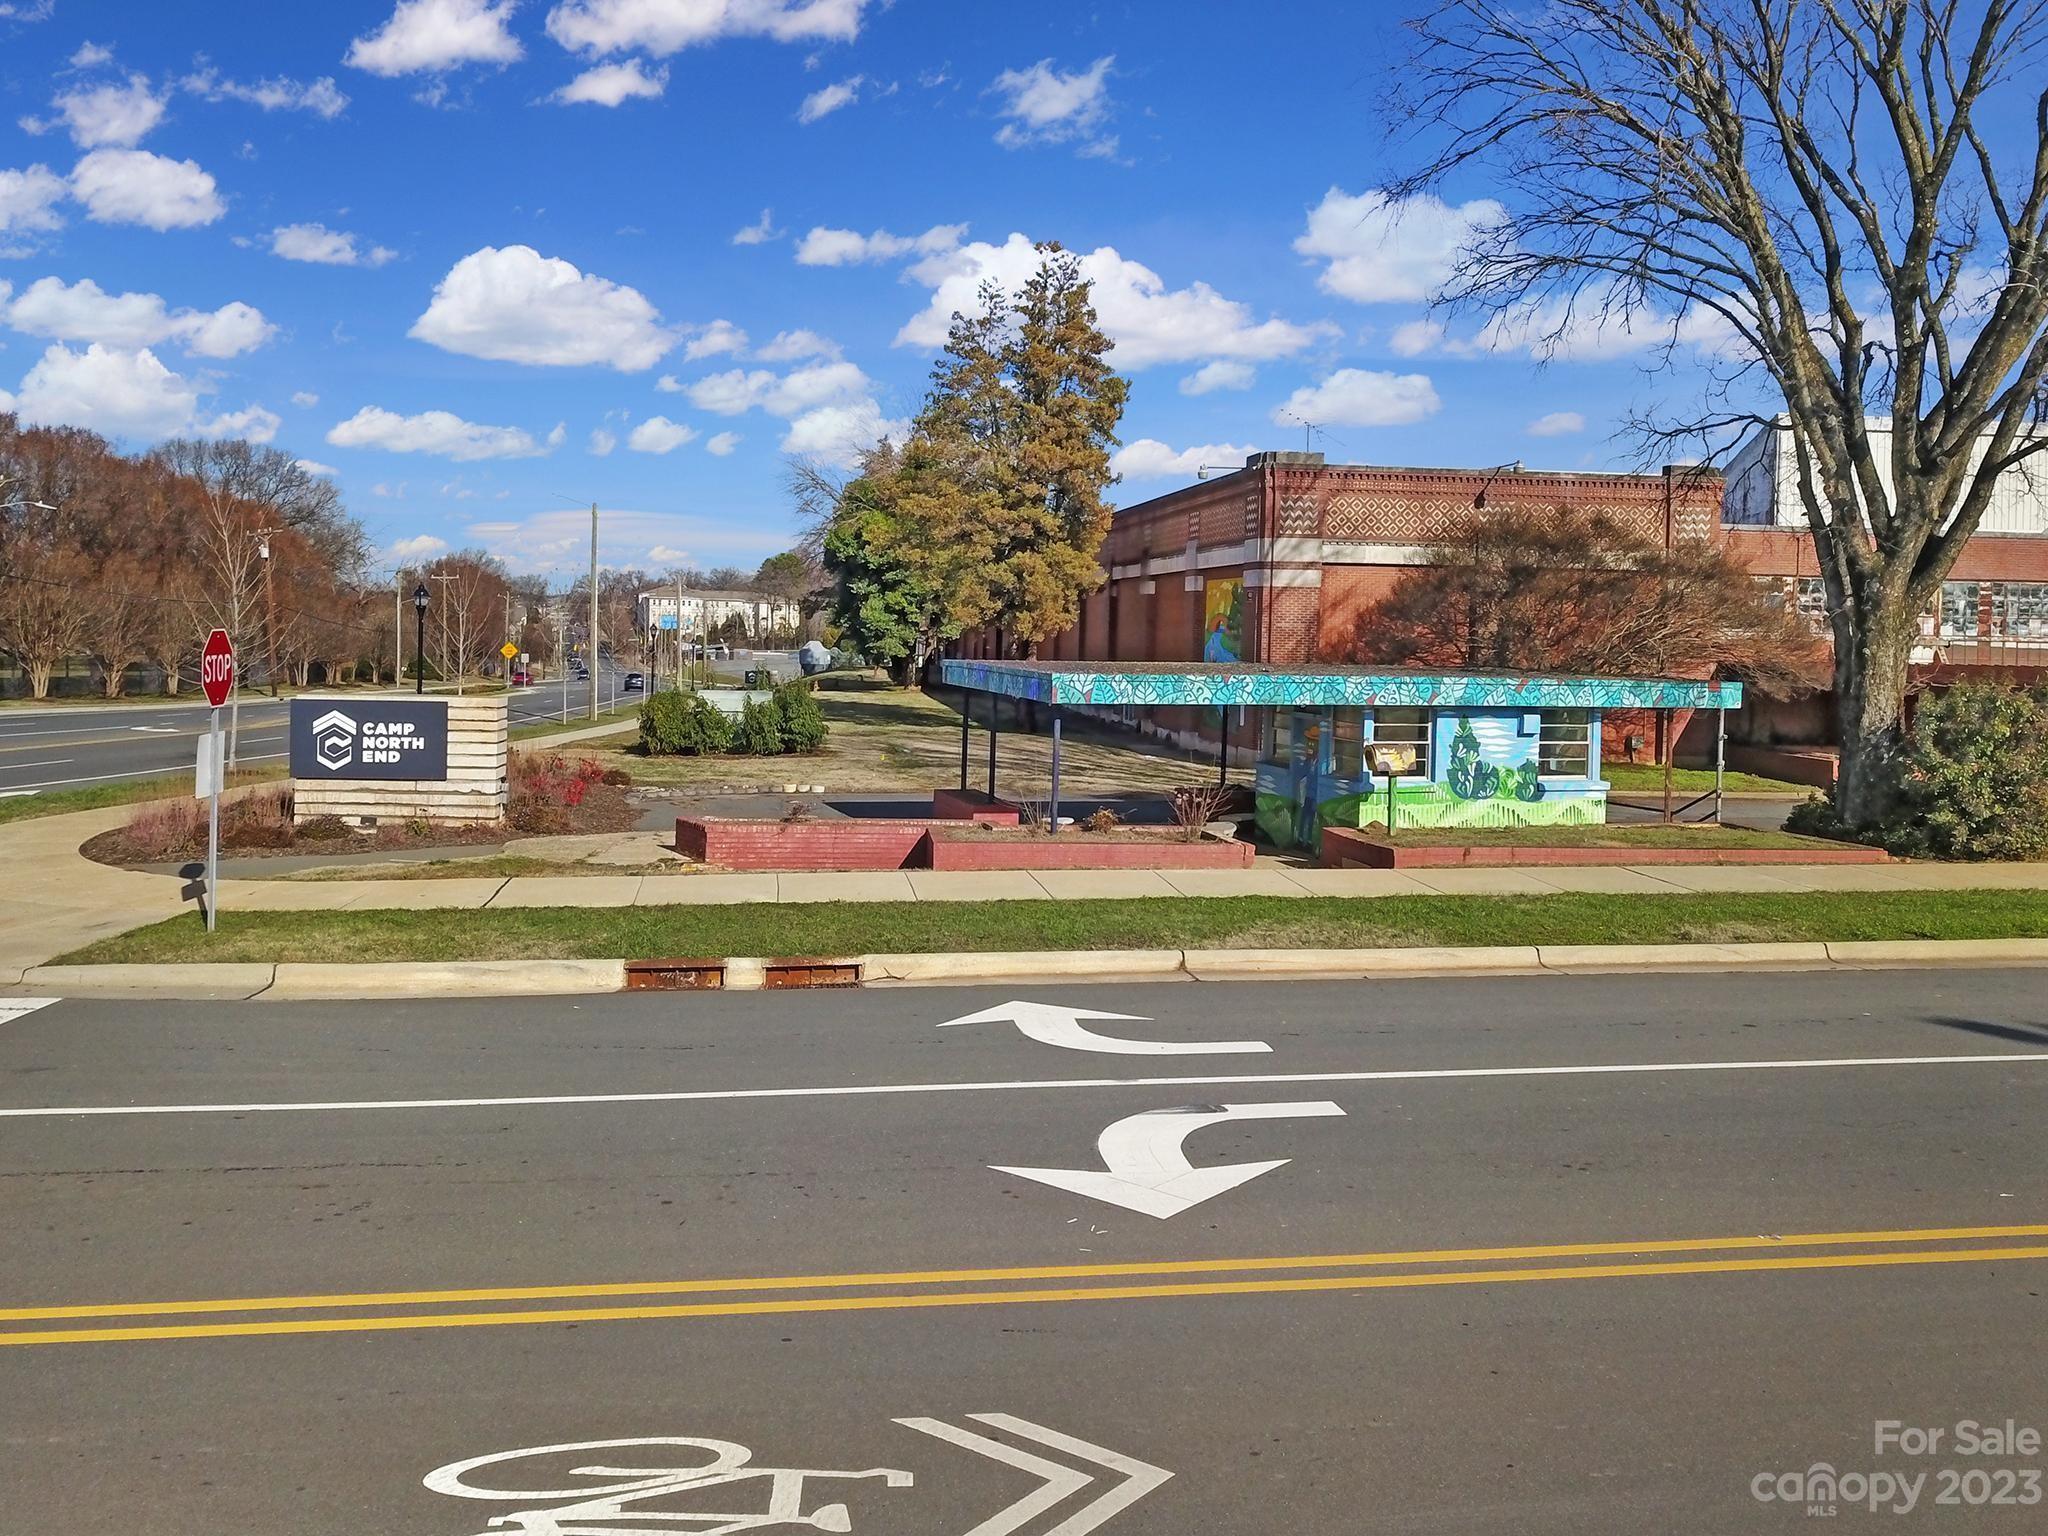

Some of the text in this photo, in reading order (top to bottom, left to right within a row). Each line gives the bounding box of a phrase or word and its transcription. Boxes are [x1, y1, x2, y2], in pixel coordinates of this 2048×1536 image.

[204, 653, 232, 684] STOP
[362, 722, 415, 736] CAMP
[362, 736, 425, 750] NORTH
[362, 750, 401, 763] END
